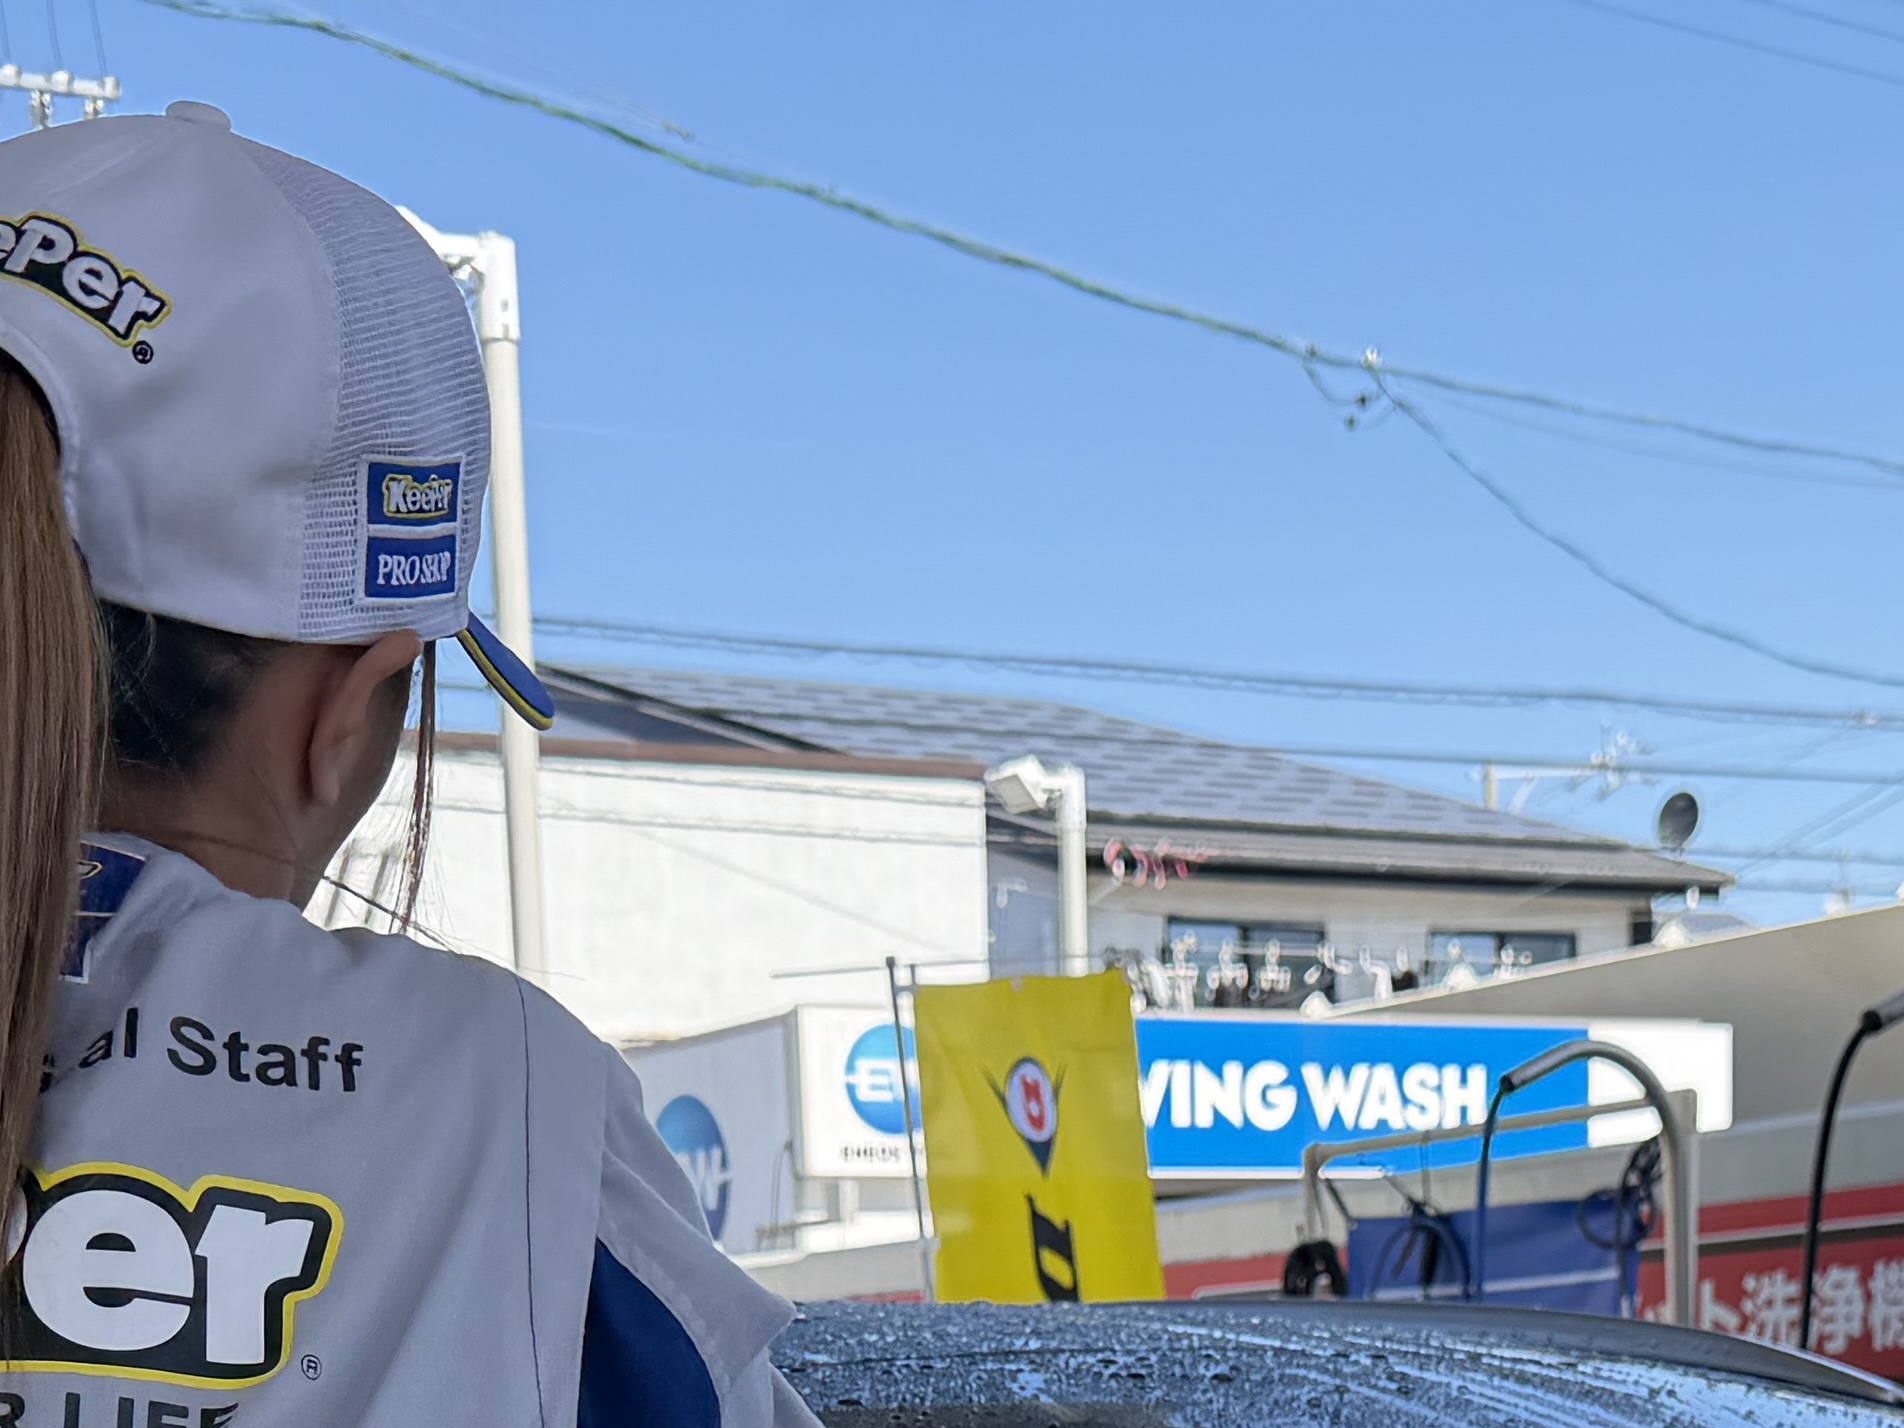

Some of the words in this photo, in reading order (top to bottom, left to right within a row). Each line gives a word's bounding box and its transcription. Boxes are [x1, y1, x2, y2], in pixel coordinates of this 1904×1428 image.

[377, 554, 420, 586] PRO
[167, 1016, 364, 1092] Staff
[1301, 1062, 1488, 1131] WASH
